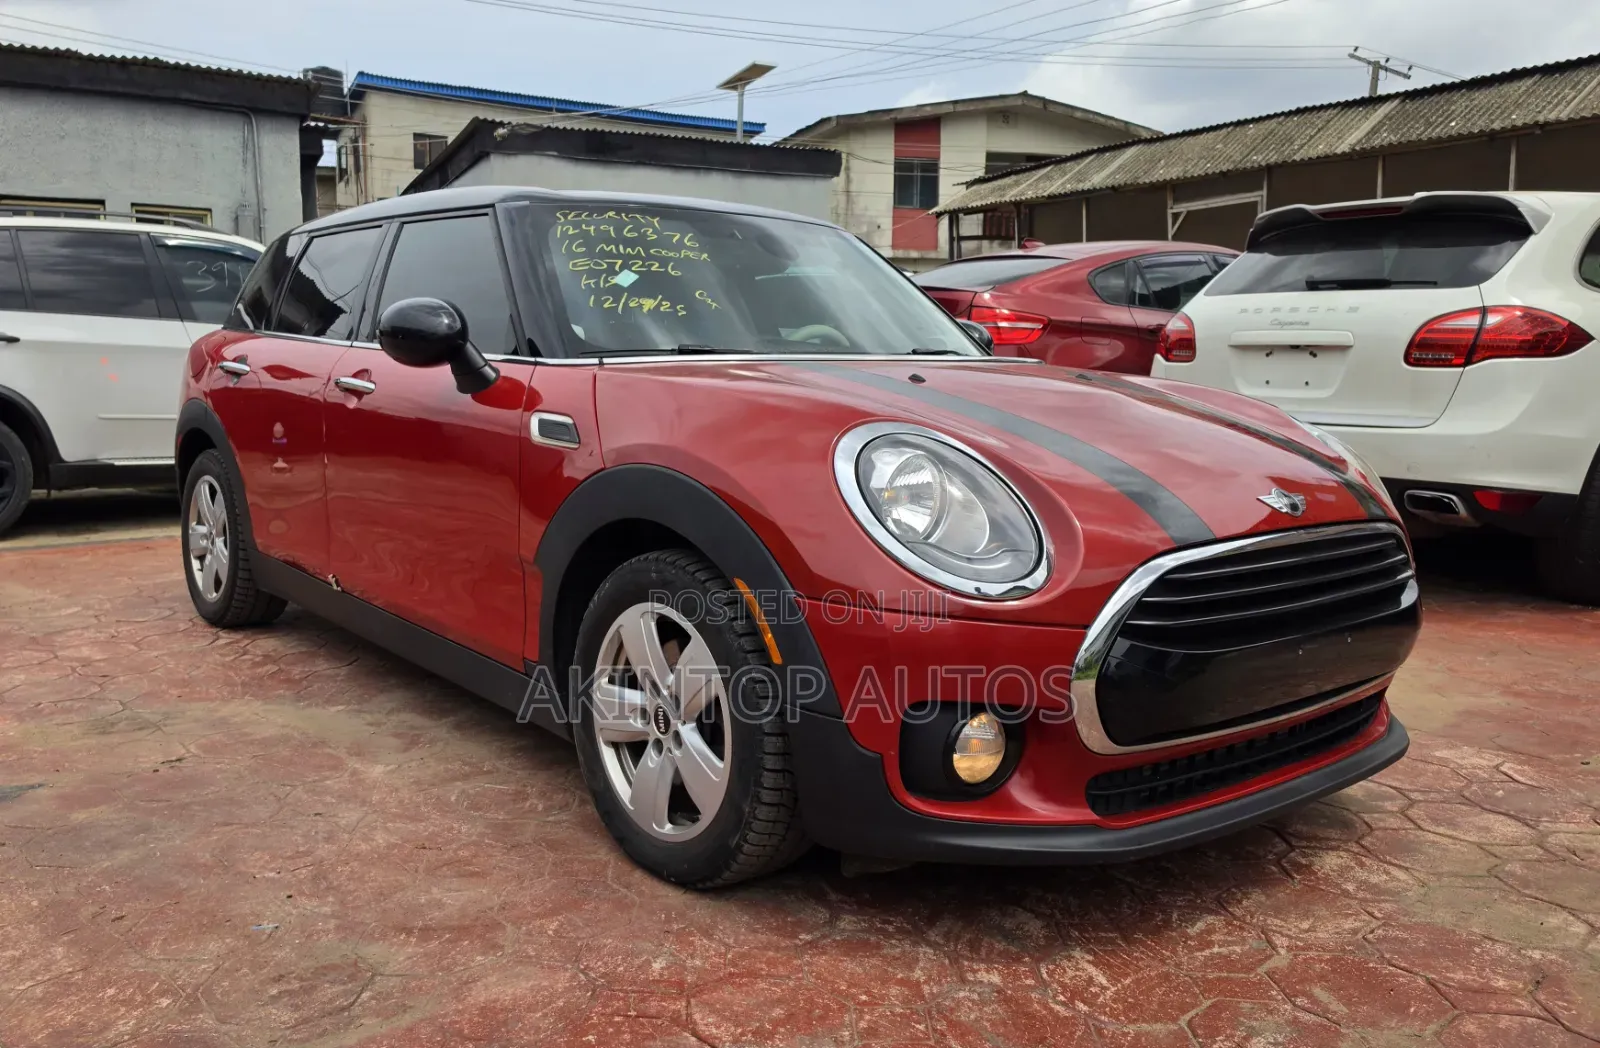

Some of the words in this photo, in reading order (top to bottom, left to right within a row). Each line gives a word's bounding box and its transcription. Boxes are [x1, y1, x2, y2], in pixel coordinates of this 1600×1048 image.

[556, 211, 660, 230] SECURITY
[557, 224, 699, 248] 12496376
[562, 240, 586, 254] 16
[650, 248, 711, 262] COOPER
[1238, 306, 1360, 315] PORSCHE
[657, 708, 666, 733] MINI
